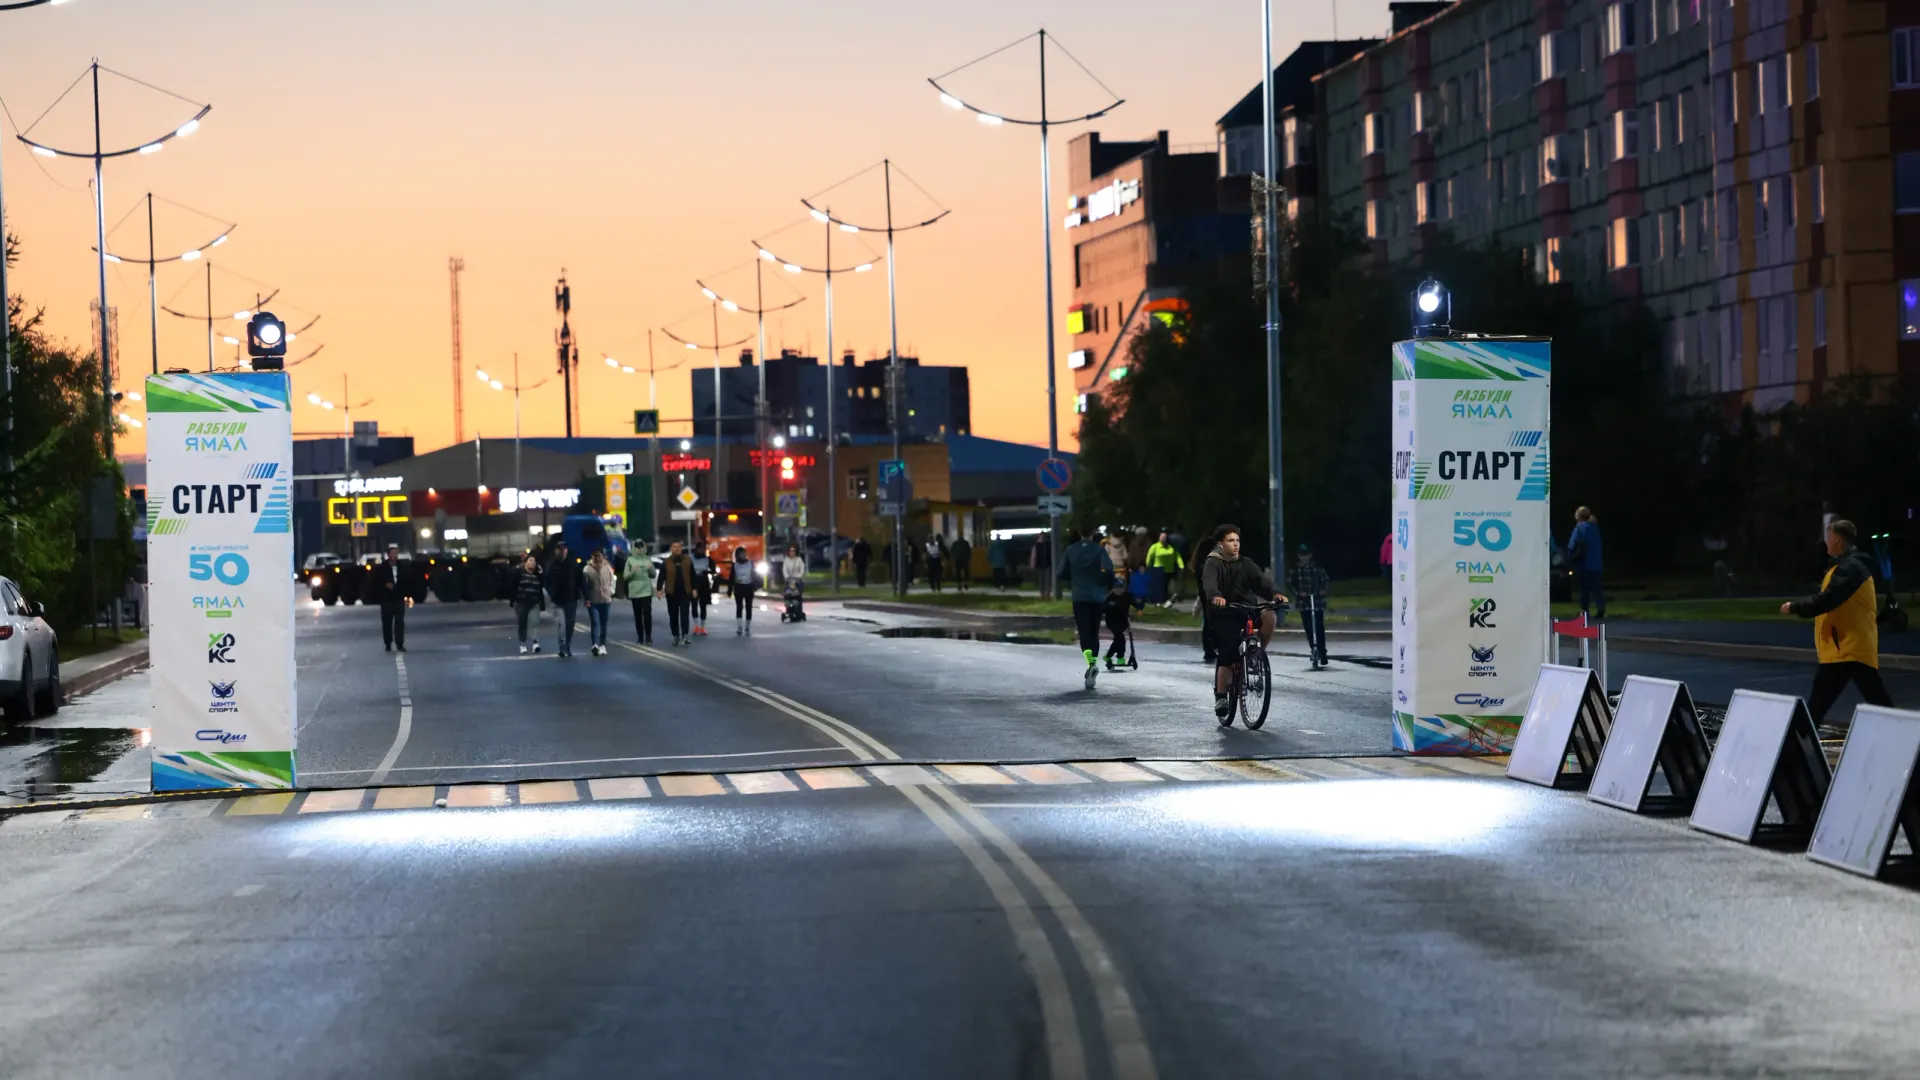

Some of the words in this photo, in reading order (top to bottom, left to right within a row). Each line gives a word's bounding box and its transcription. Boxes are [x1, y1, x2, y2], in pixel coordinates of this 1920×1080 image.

[1453, 390, 1512, 403] РАЗБУДИ
[1452, 404, 1512, 418] ЯМАЛ
[186, 422, 248, 435] РАЗБУДИ
[185, 437, 248, 451] ЯМАЛ
[1438, 450, 1525, 481] СТАРТ
[172, 484, 262, 515] СТАРТ
[1453, 518, 1513, 552] 50
[189, 553, 250, 586] 50
[1456, 561, 1506, 573] ЯМАЛ
[192, 596, 245, 608] ЯМАЛ
